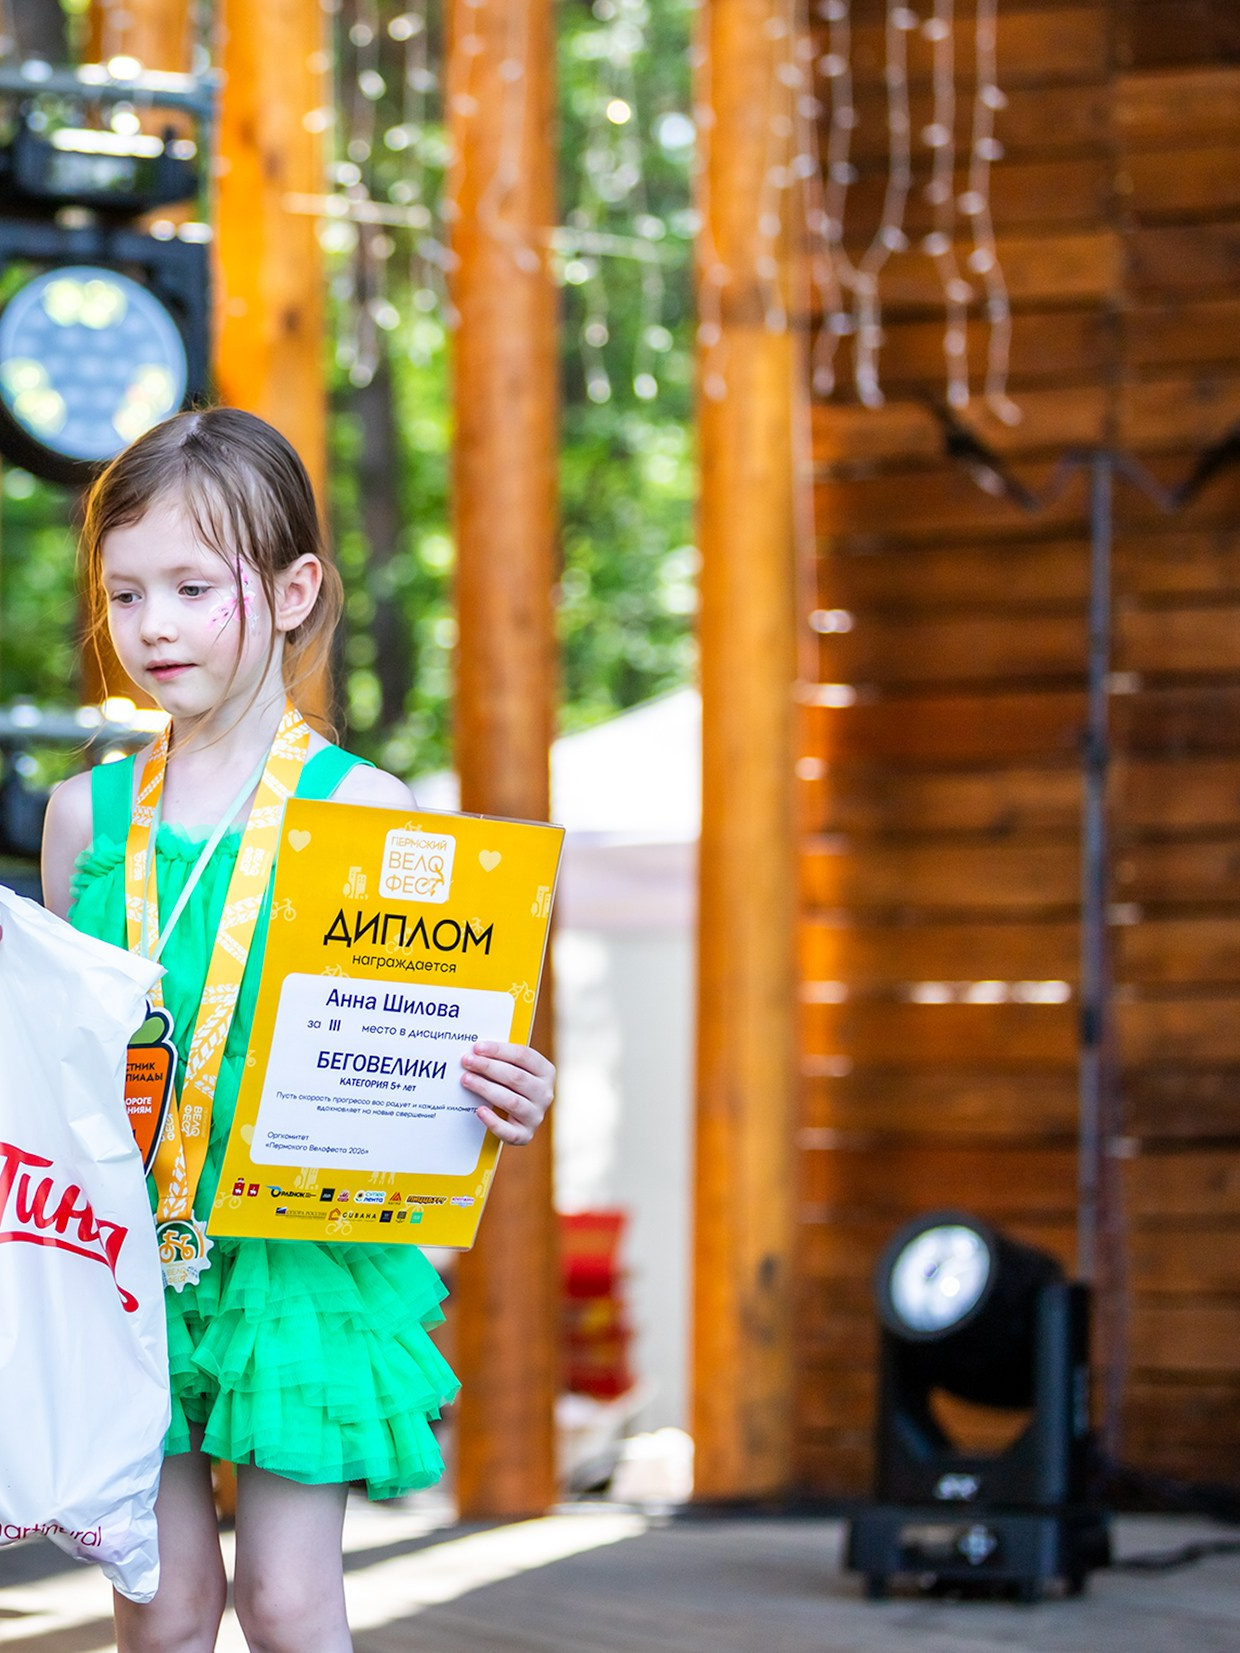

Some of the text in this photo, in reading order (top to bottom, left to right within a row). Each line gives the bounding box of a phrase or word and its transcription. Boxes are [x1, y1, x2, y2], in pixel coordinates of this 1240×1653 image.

[392, 836, 447, 851] ПЕРМСКИЙ
[389, 851, 444, 874] ВЕЛО
[386, 874, 444, 896] ФЕСТ
[323, 908, 494, 955] ДИПЛОМ
[352, 954, 457, 973] награждается
[326, 988, 460, 1018] Анна Шилова
[307, 1019, 478, 1042] за III место в дисциплине
[317, 1051, 447, 1079] БЕГОВЕЛИКИ
[126, 1073, 163, 1082] ПИАДЫ
[339, 1077, 388, 1090] КАТЕГОРИЯ
[390, 1081, 401, 1091] 5+
[125, 1097, 152, 1105] ОРОГЕ
[276, 1091, 297, 1100] Пусть
[299, 1094, 331, 1103] скорость
[333, 1097, 370, 1105] прогресса
[127, 1106, 152, 1114] НИЯМ
[317, 1105, 361, 1114] вдохновляет
[267, 1131, 309, 1140] Оргкомитет
[309, 1144, 347, 1154] Велофеста
